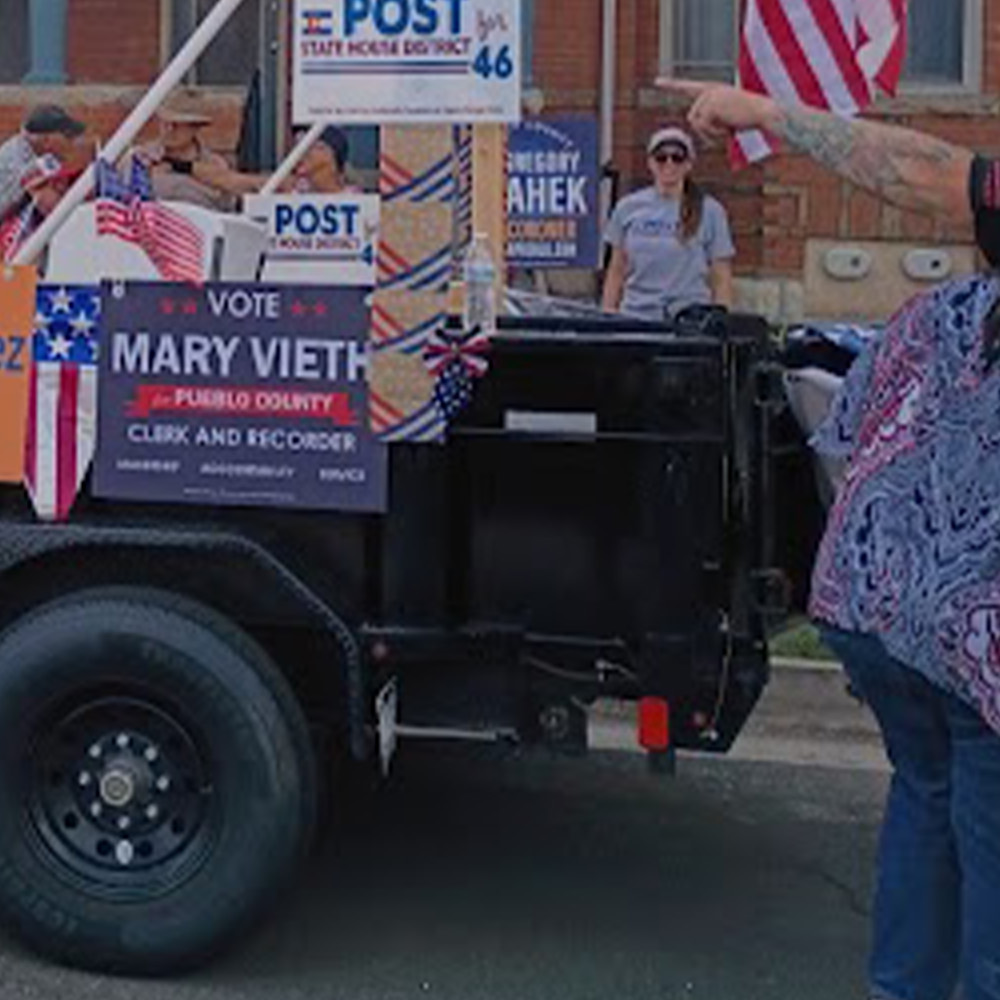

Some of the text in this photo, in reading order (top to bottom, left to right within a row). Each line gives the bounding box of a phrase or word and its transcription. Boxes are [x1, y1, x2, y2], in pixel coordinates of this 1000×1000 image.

[474, 44, 514, 79] 46
[275, 204, 359, 235] POST
[207, 290, 281, 318] VOTE
[112, 332, 371, 381] MARY VIETH
[174, 388, 249, 407] PUEBLO
[255, 391, 334, 411] COUNTY
[127, 424, 190, 445] CLERK
[196, 428, 242, 446] AND
